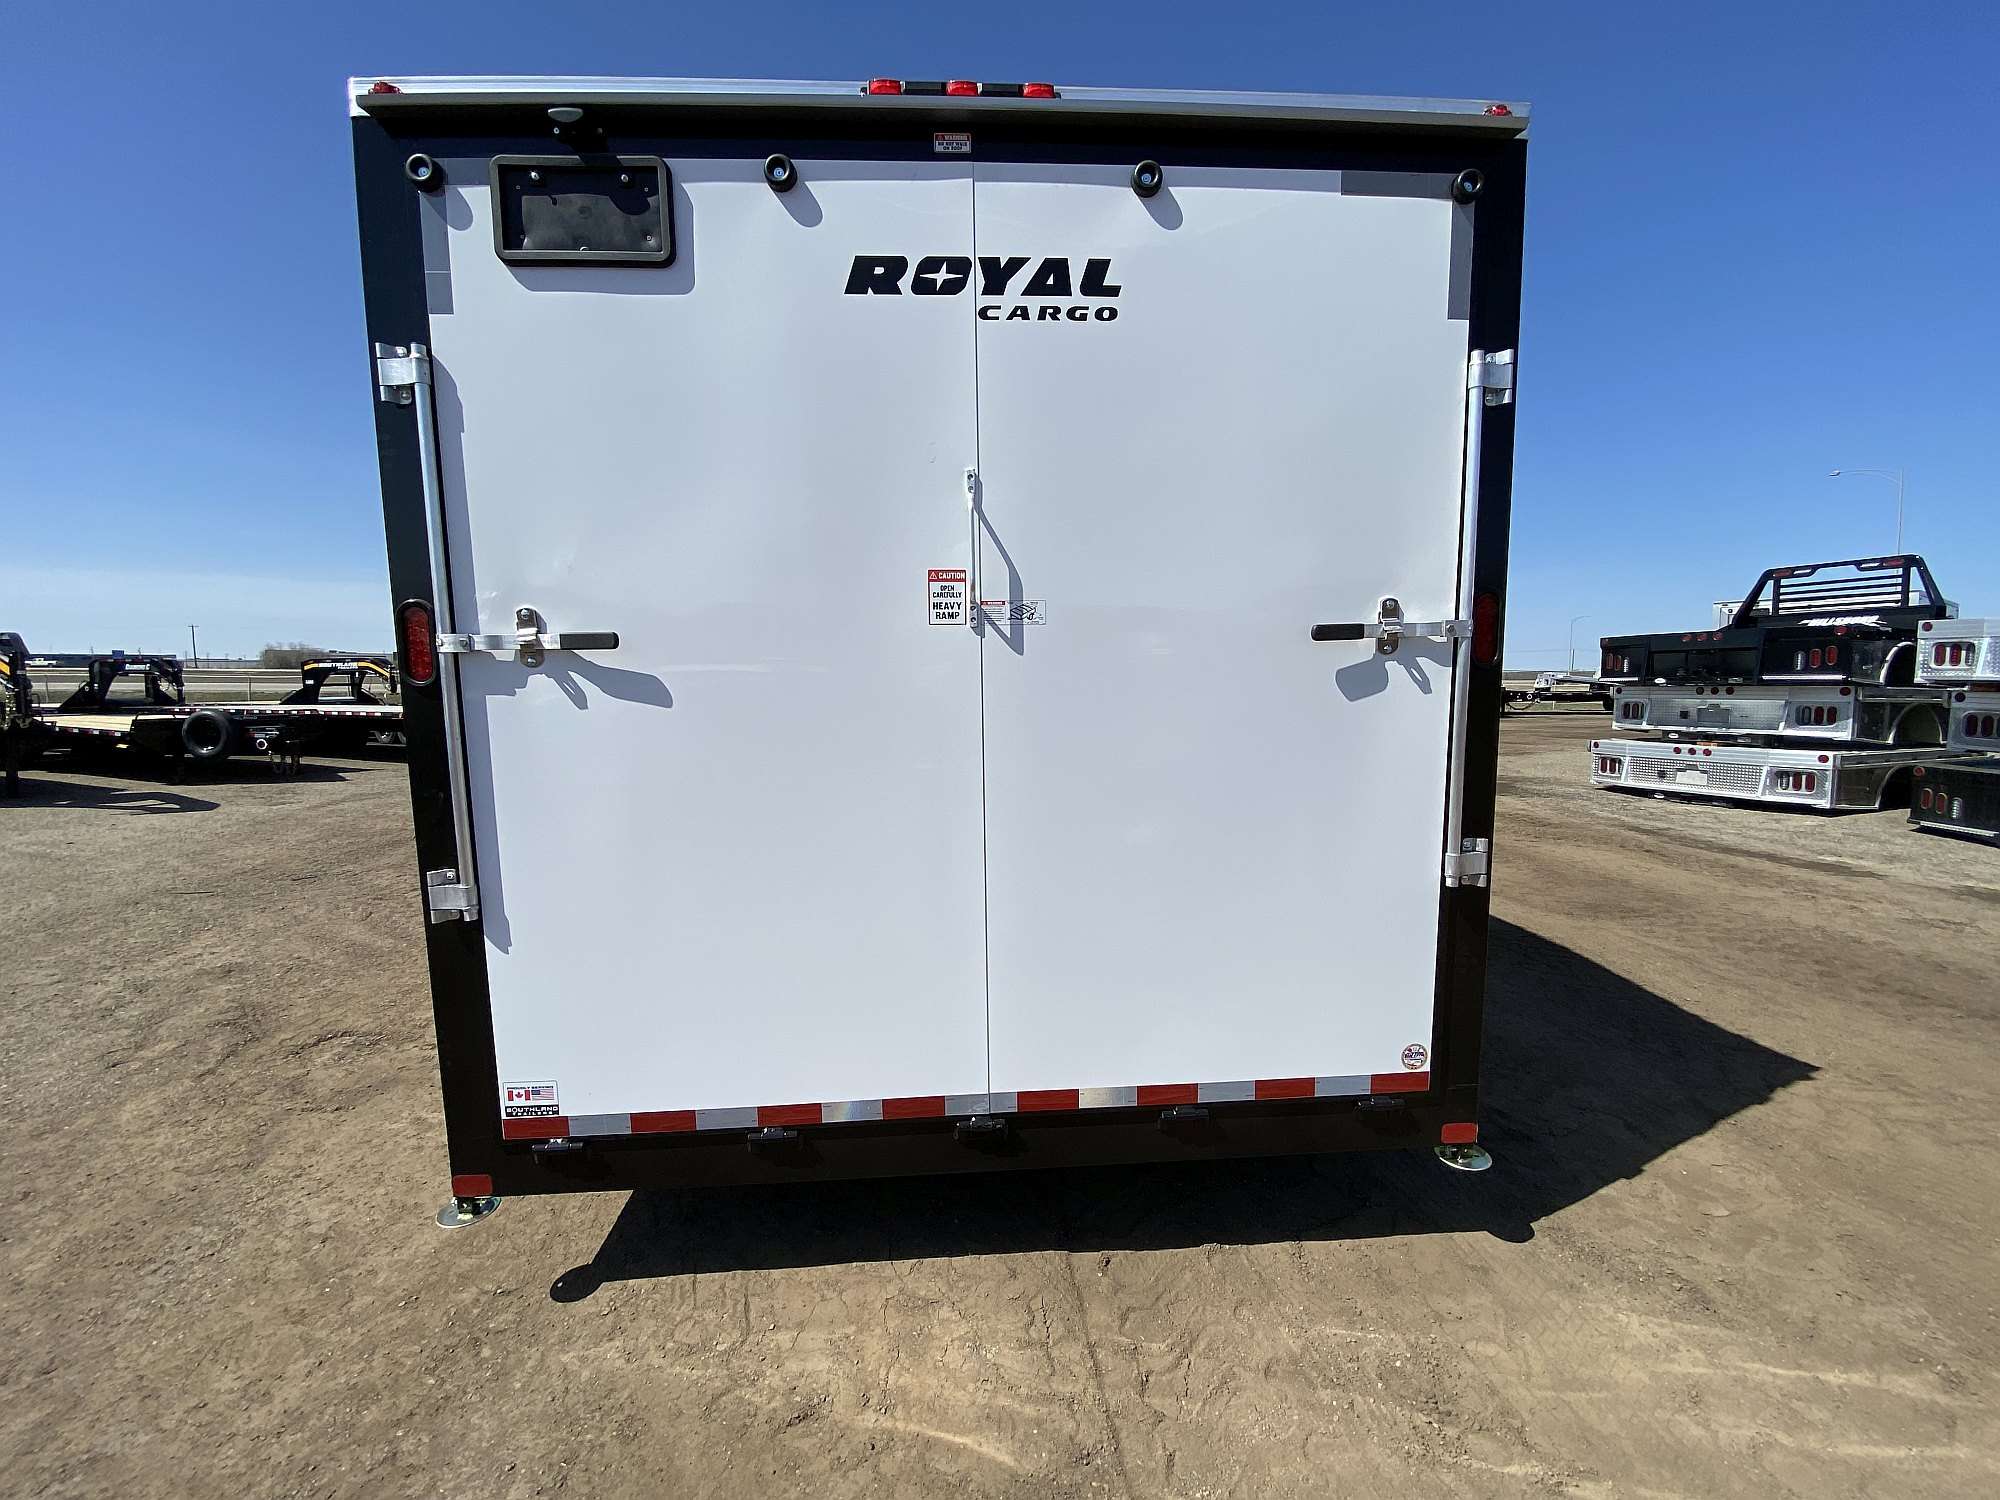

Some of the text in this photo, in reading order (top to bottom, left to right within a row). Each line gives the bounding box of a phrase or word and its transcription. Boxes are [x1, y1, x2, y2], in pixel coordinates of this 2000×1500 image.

[844, 255, 1122, 298] ROYAL
[978, 305, 1119, 322] CARGO
[938, 572, 966, 580] CAUTION
[933, 602, 962, 610] HEAVY
[936, 612, 960, 620] RAMP
